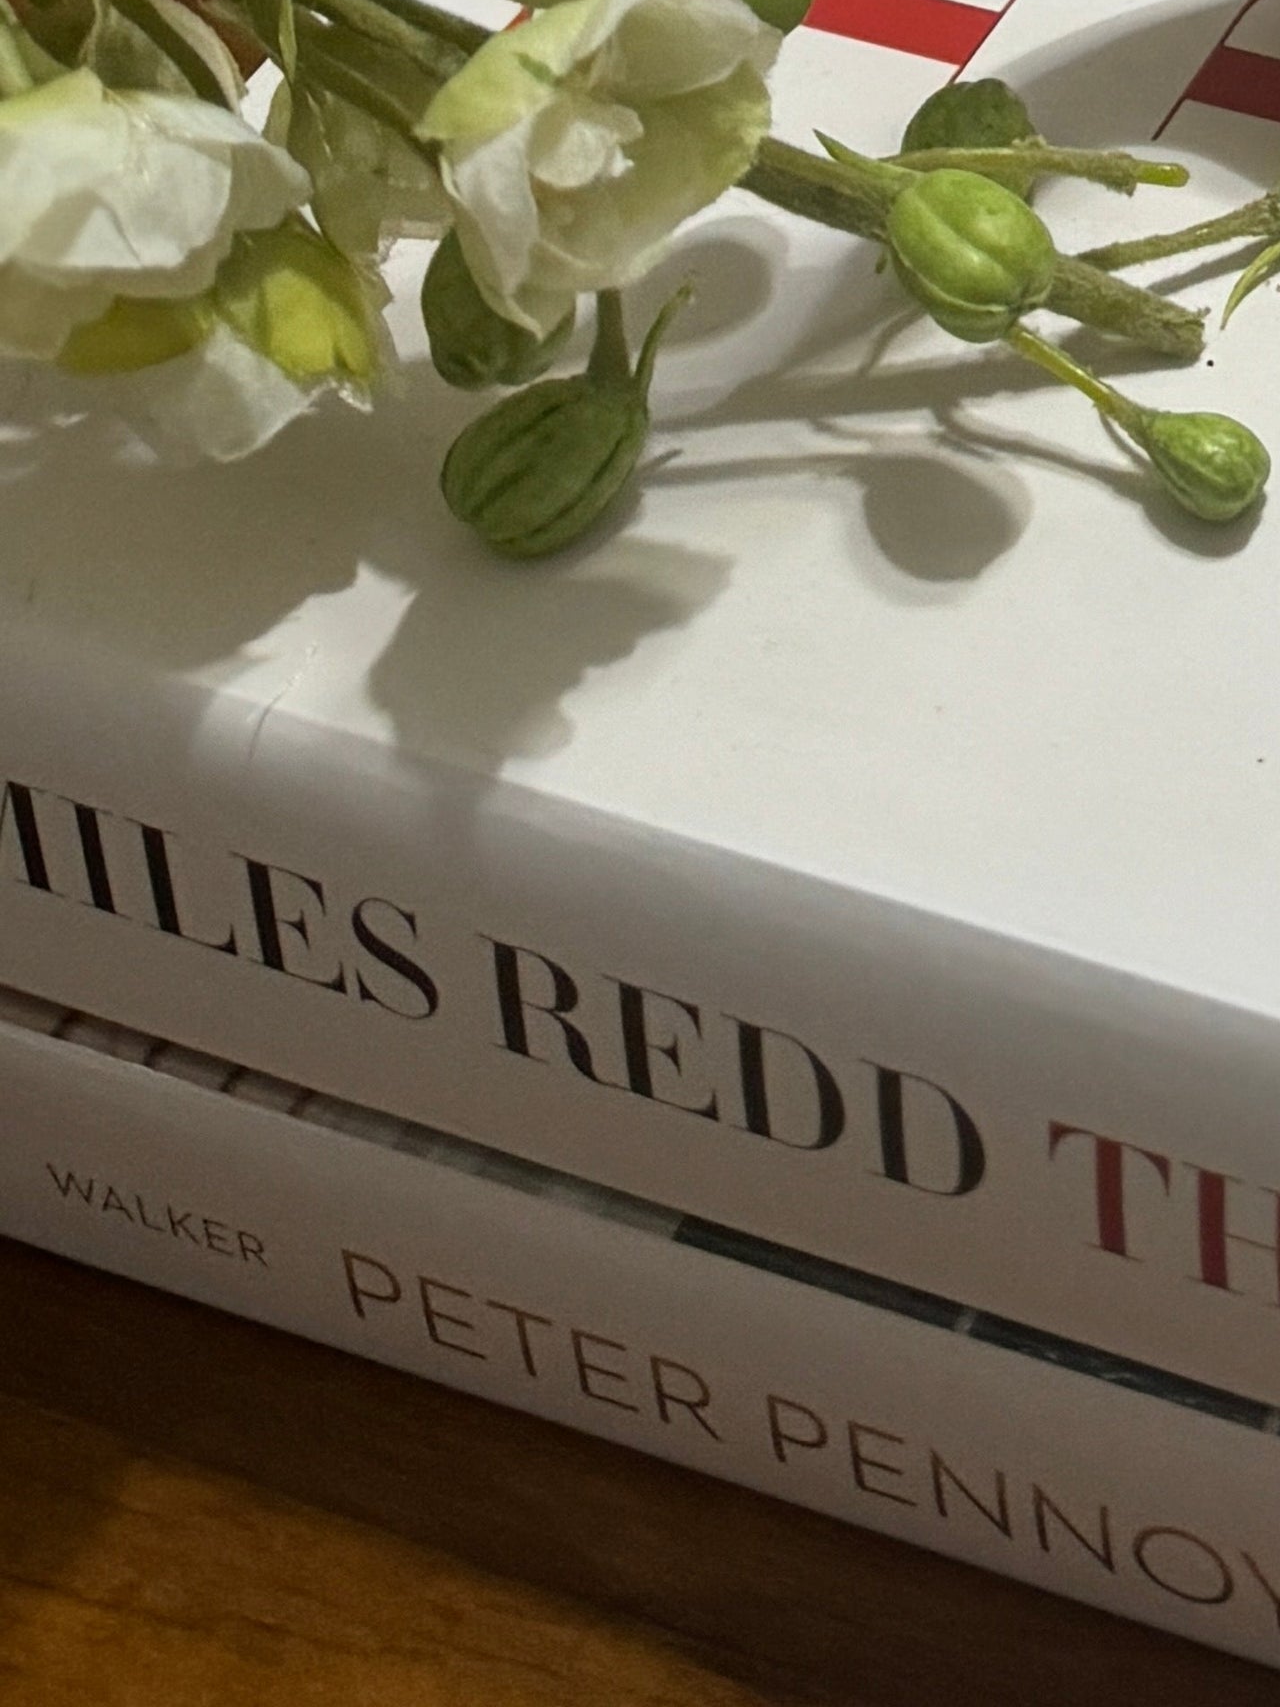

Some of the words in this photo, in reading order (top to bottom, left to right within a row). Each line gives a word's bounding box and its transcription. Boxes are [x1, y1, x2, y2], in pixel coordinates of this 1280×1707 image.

[476, 933, 986, 1196] REDD
[46, 1162, 268, 1267] WALKER
[341, 1249, 721, 1441] PETER
